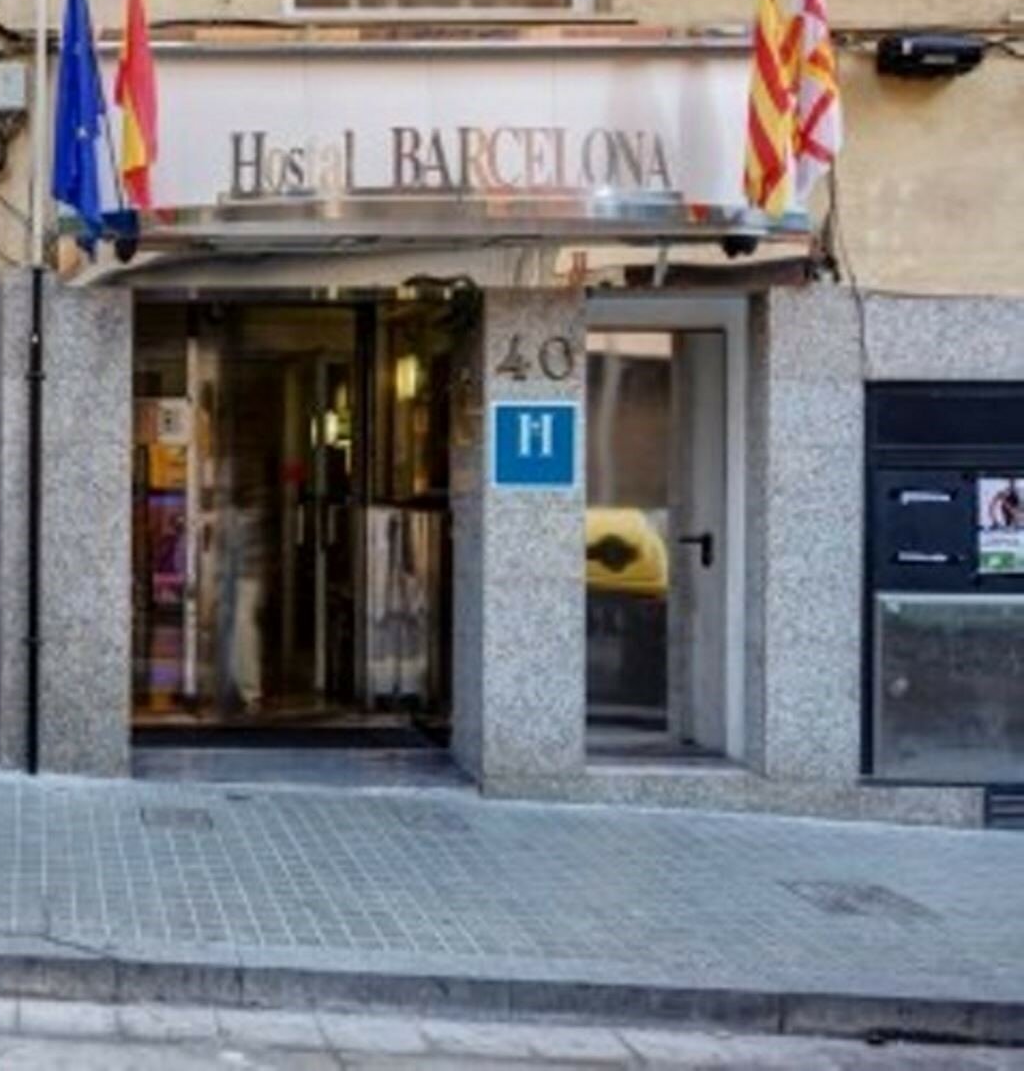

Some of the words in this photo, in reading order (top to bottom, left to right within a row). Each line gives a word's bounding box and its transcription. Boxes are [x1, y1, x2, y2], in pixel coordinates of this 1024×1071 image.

[230, 128, 356, 197] Hostal
[392, 125, 674, 193] BARCELONA
[495, 333, 574, 381] 40
[517, 413, 556, 458] H
